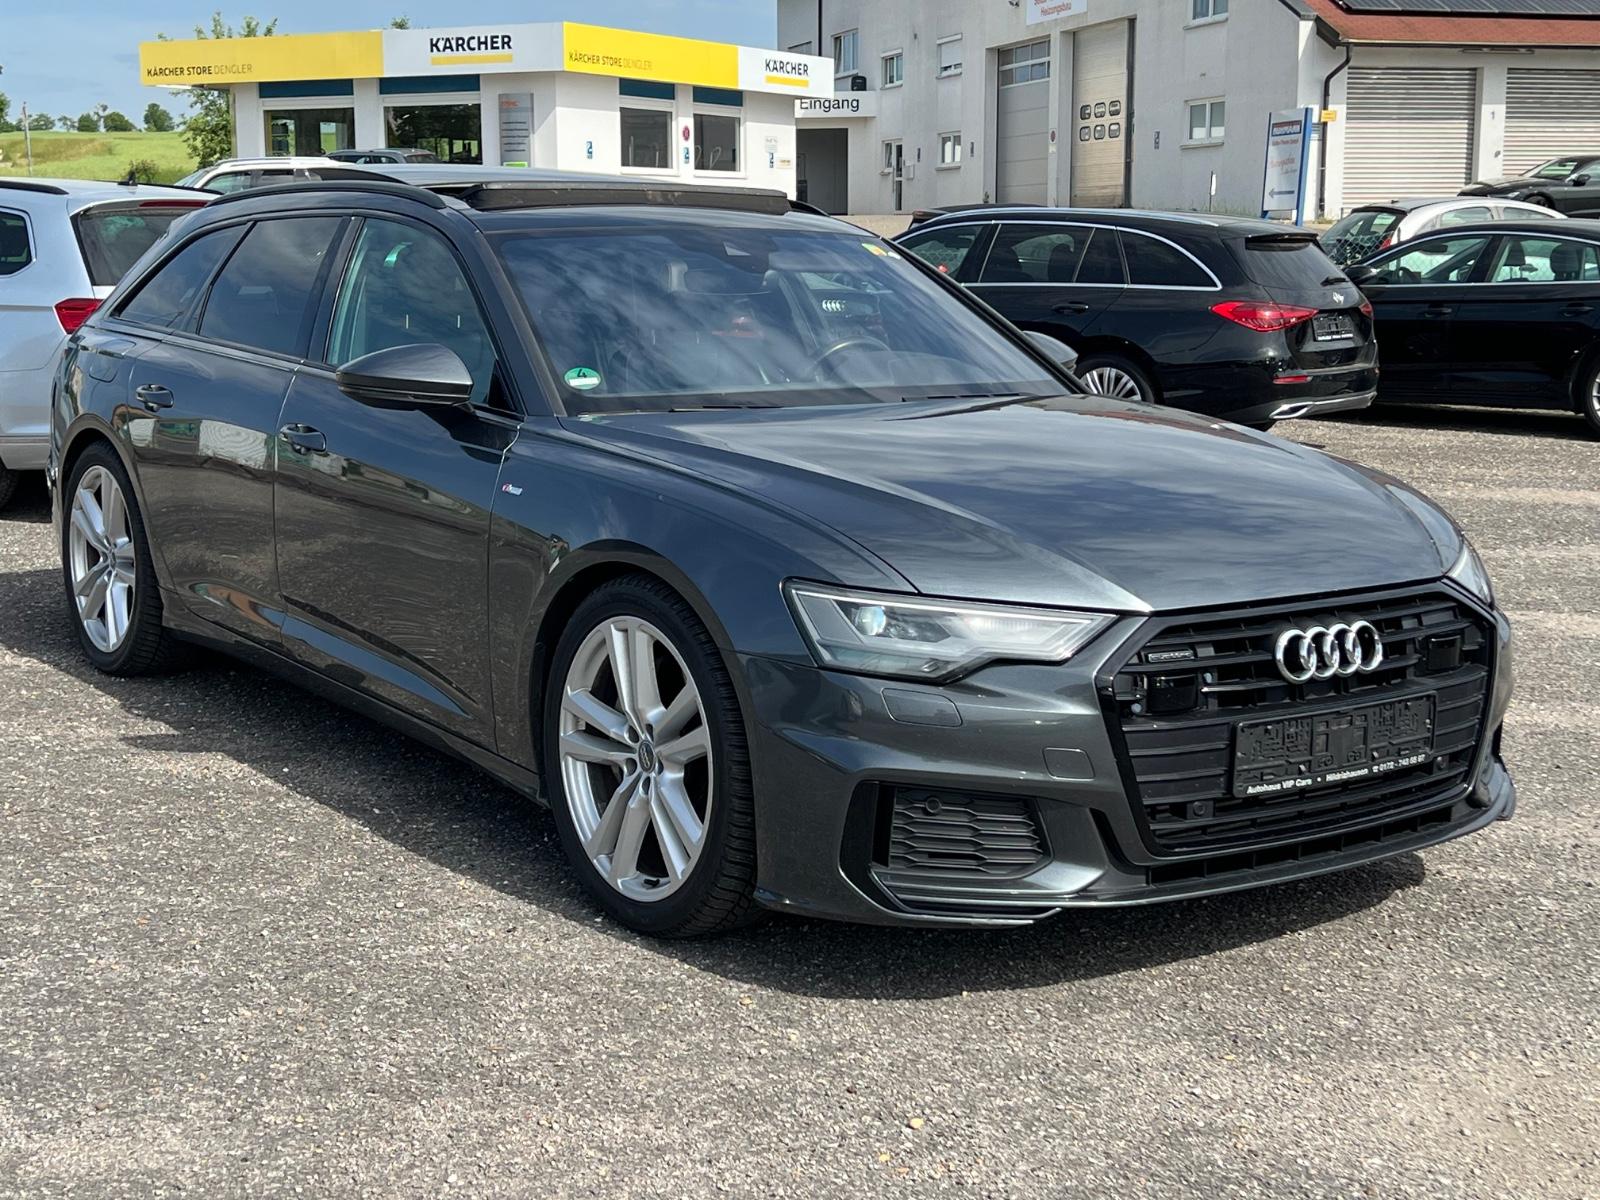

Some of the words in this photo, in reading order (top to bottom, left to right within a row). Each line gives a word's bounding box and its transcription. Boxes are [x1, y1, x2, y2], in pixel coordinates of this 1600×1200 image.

[430, 35, 512, 53] KÄRCHER
[569, 50, 601, 64] KÄRCHER
[601, 56, 622, 67] STORE
[147, 66, 184, 77] KÄRCHER
[187, 65, 213, 76] STORE
[214, 63, 253, 75] DENGLER
[765, 59, 809, 76] KÄRCHER
[800, 98, 860, 113] Eingang
[1246, 783, 1281, 794] Autohaus
[1282, 780, 1295, 789] VIP
[1296, 779, 1312, 787] Cars
